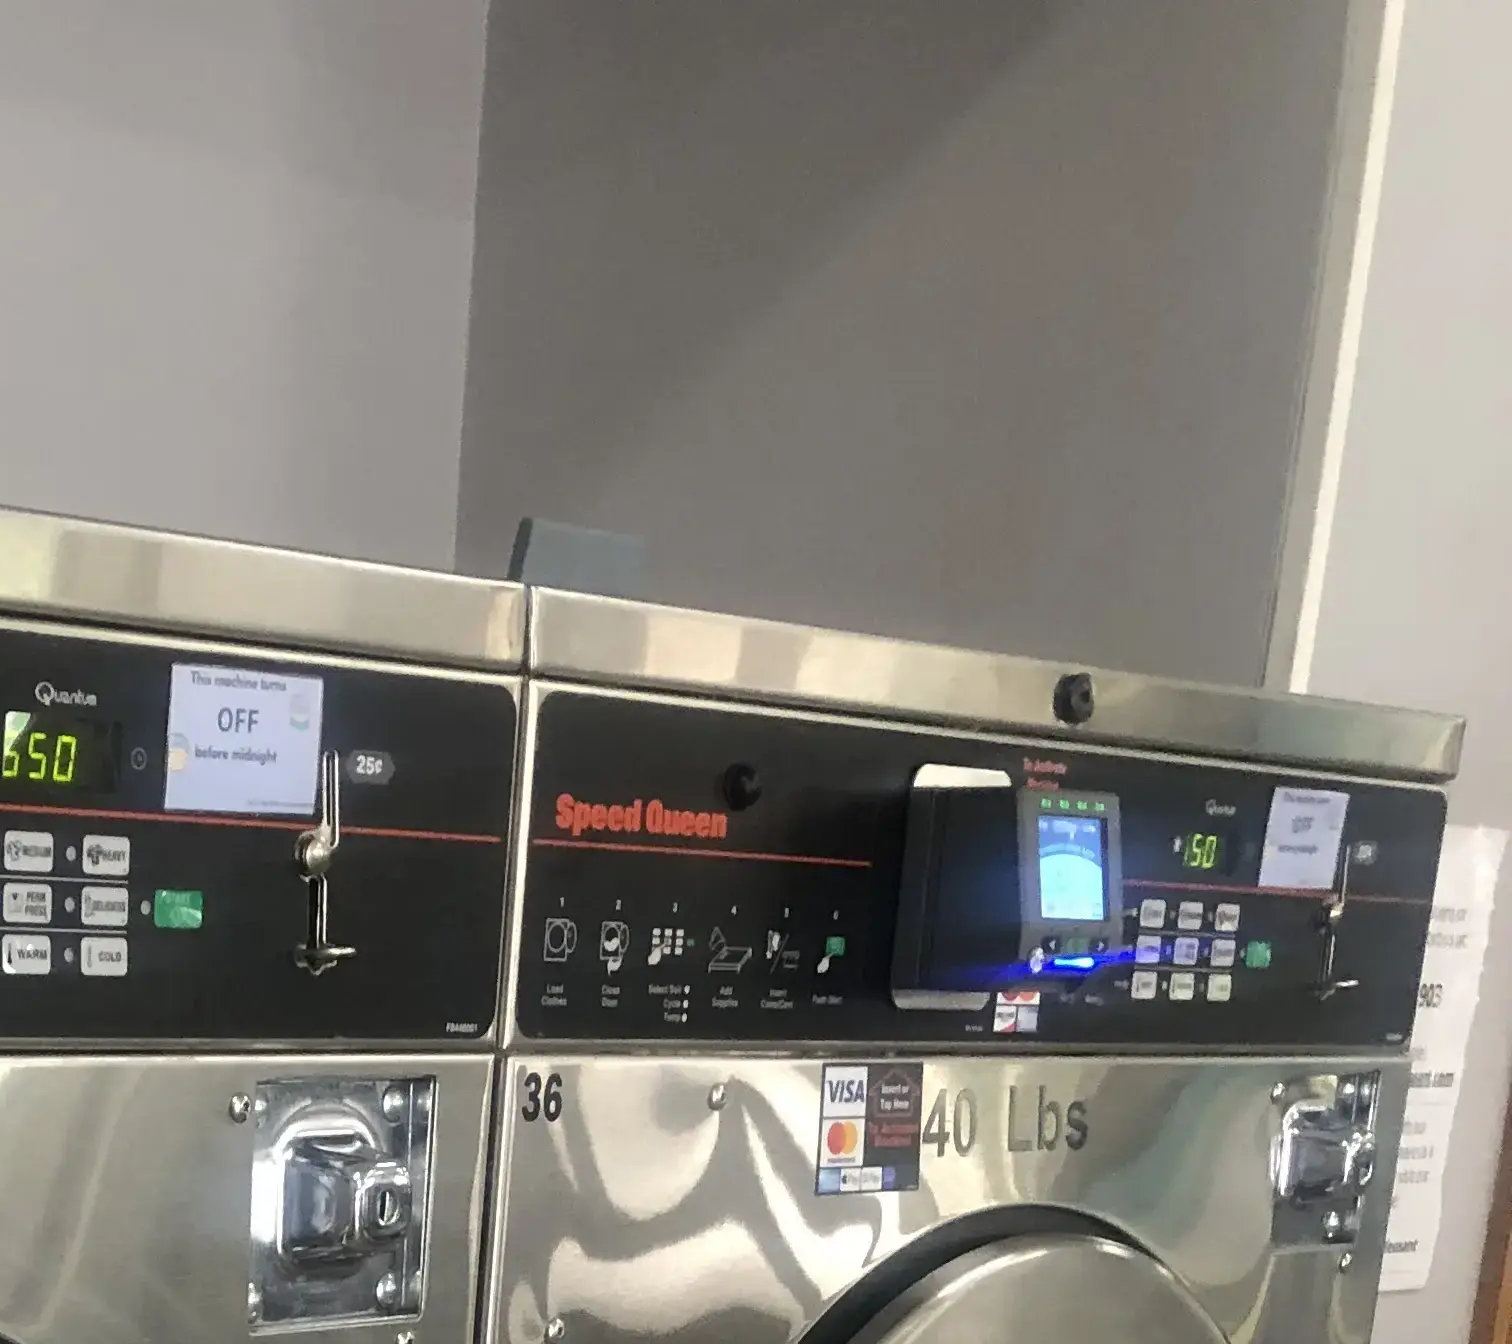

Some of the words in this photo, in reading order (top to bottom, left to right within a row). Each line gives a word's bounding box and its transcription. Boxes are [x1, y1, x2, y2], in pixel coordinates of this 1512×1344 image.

[191, 671, 211, 685] This
[214, 674, 258, 690] machine
[261, 680, 287, 692] turns
[218, 707, 259, 734] OFF
[195, 744, 228, 760] before
[231, 746, 278, 766] midnight
[556, 794, 641, 836] Speed
[646, 799, 729, 839] Queen
[521, 1072, 563, 1122] 36
[827, 1079, 865, 1104] VISA
[922, 1087, 977, 1158] 40
[1007, 1086, 1090, 1153] Lbs
